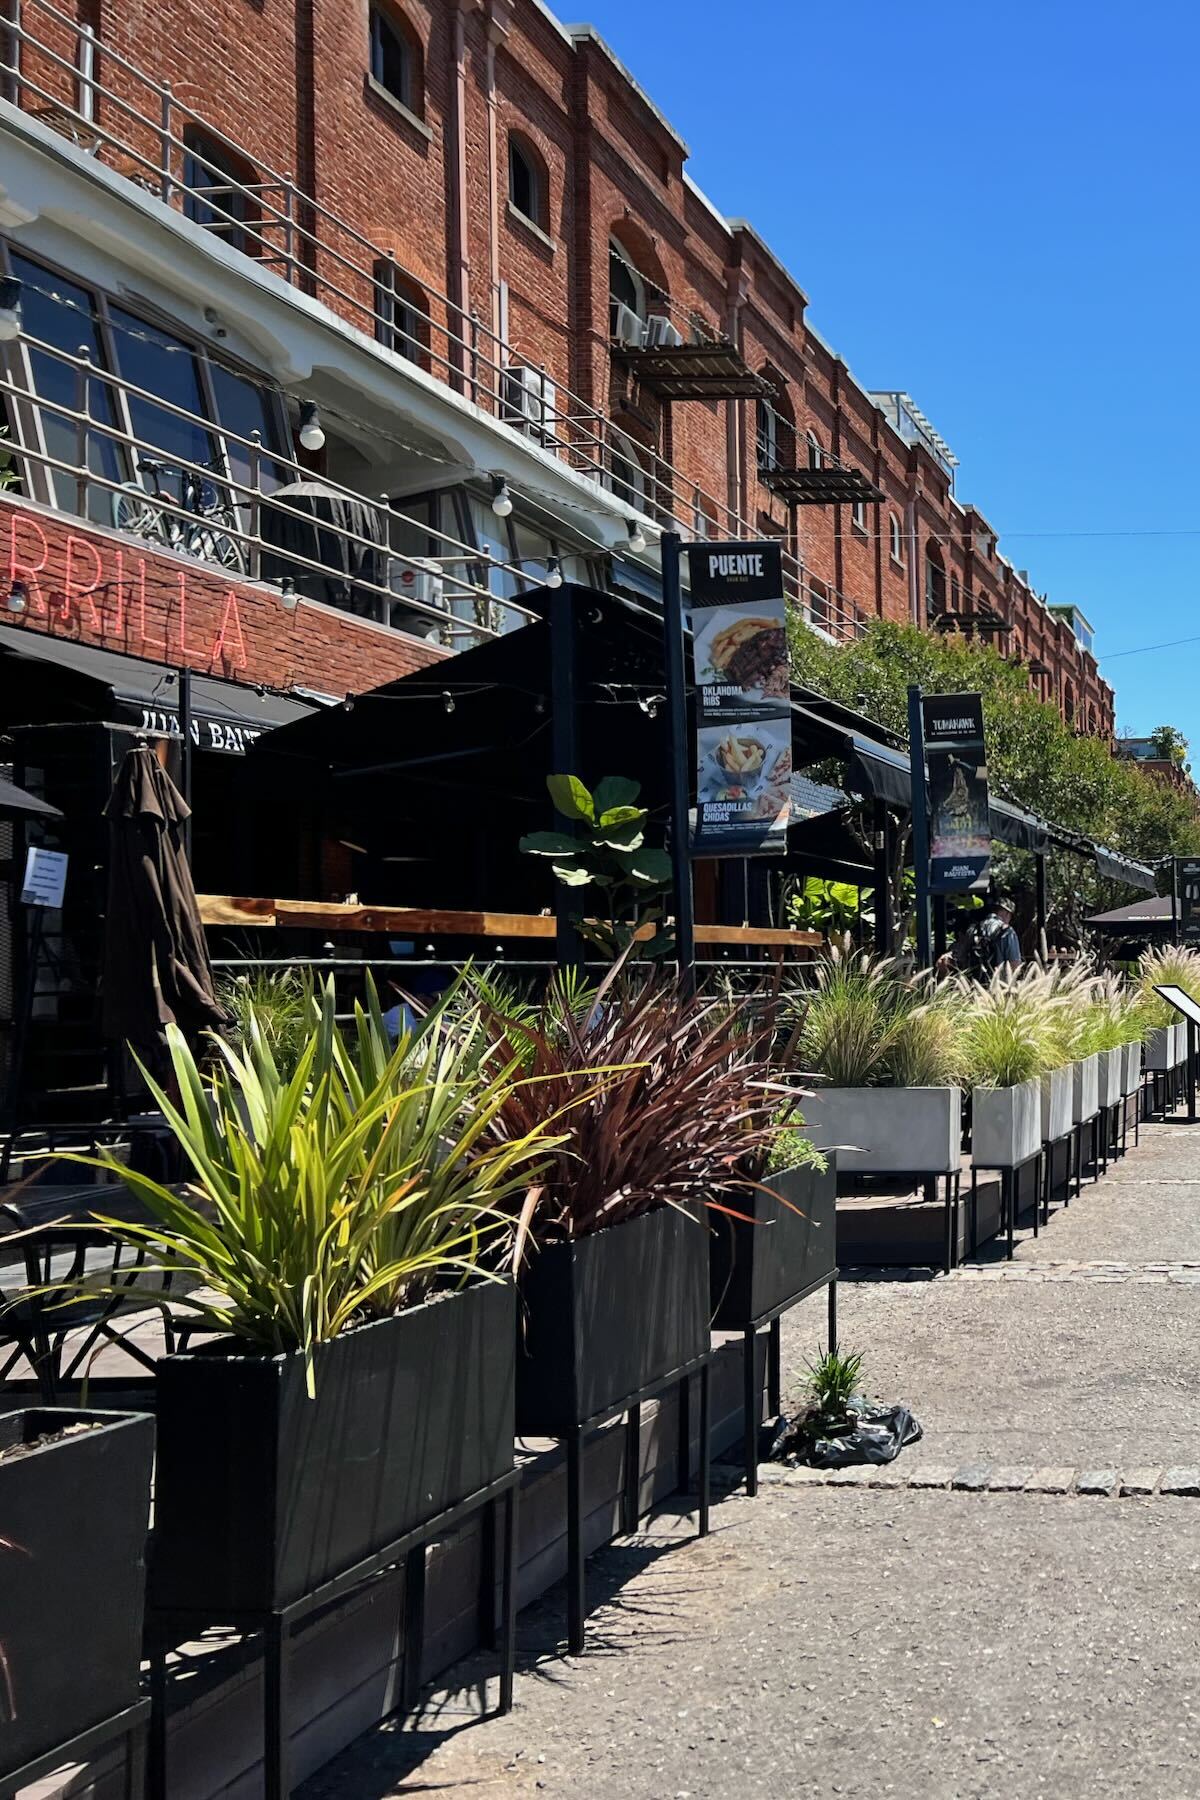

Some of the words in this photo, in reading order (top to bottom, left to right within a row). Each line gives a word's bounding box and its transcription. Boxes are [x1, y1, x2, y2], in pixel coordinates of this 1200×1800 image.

[709, 554, 764, 578] PUENTE
[702, 686, 743, 697] OKLAHOMA
[703, 696, 720, 706] RIBS
[703, 802, 752, 813] QUESADILLAS
[703, 812, 730, 822] CHIDAS
